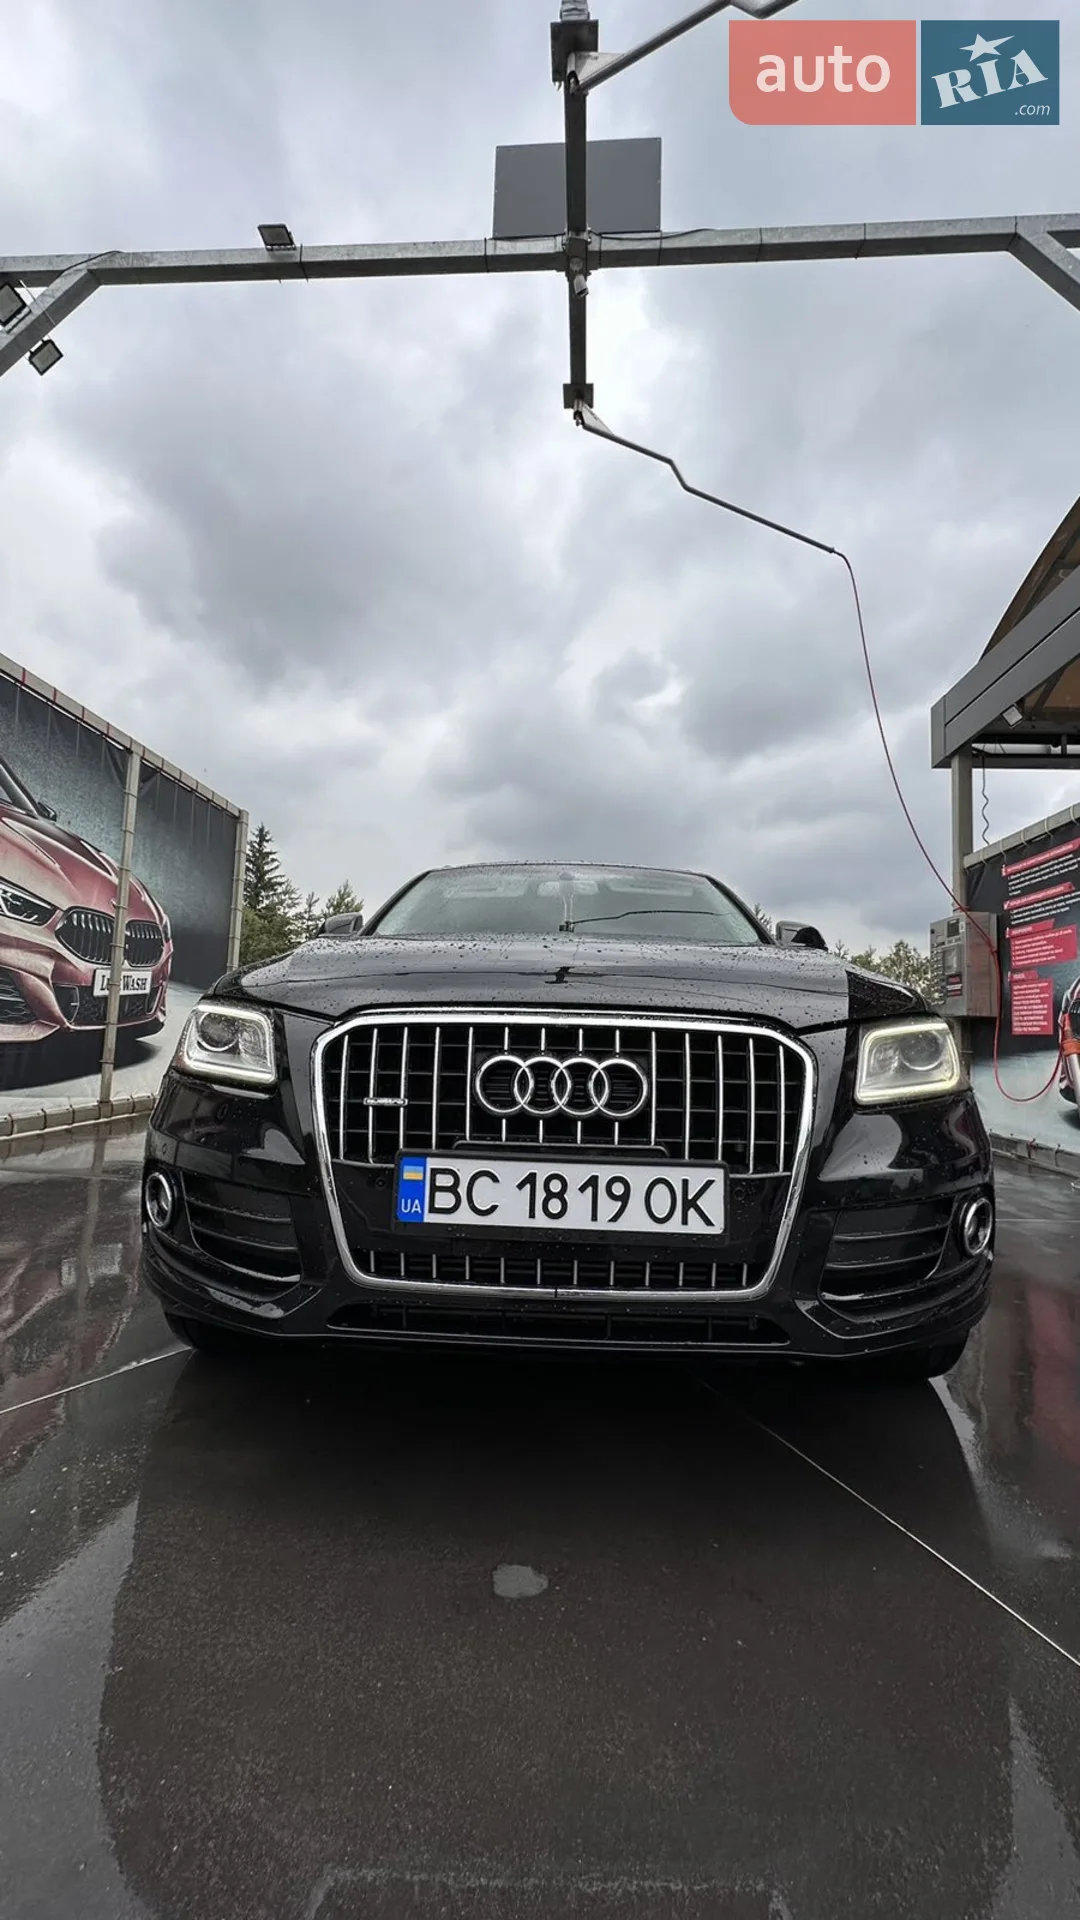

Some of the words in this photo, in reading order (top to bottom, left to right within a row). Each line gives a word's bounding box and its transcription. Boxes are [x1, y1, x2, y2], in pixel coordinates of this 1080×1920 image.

[401, 1198, 422, 1214] UA
[428, 1167, 500, 1216] BC
[515, 1171, 631, 1223] 1819
[644, 1176, 716, 1227] OK
